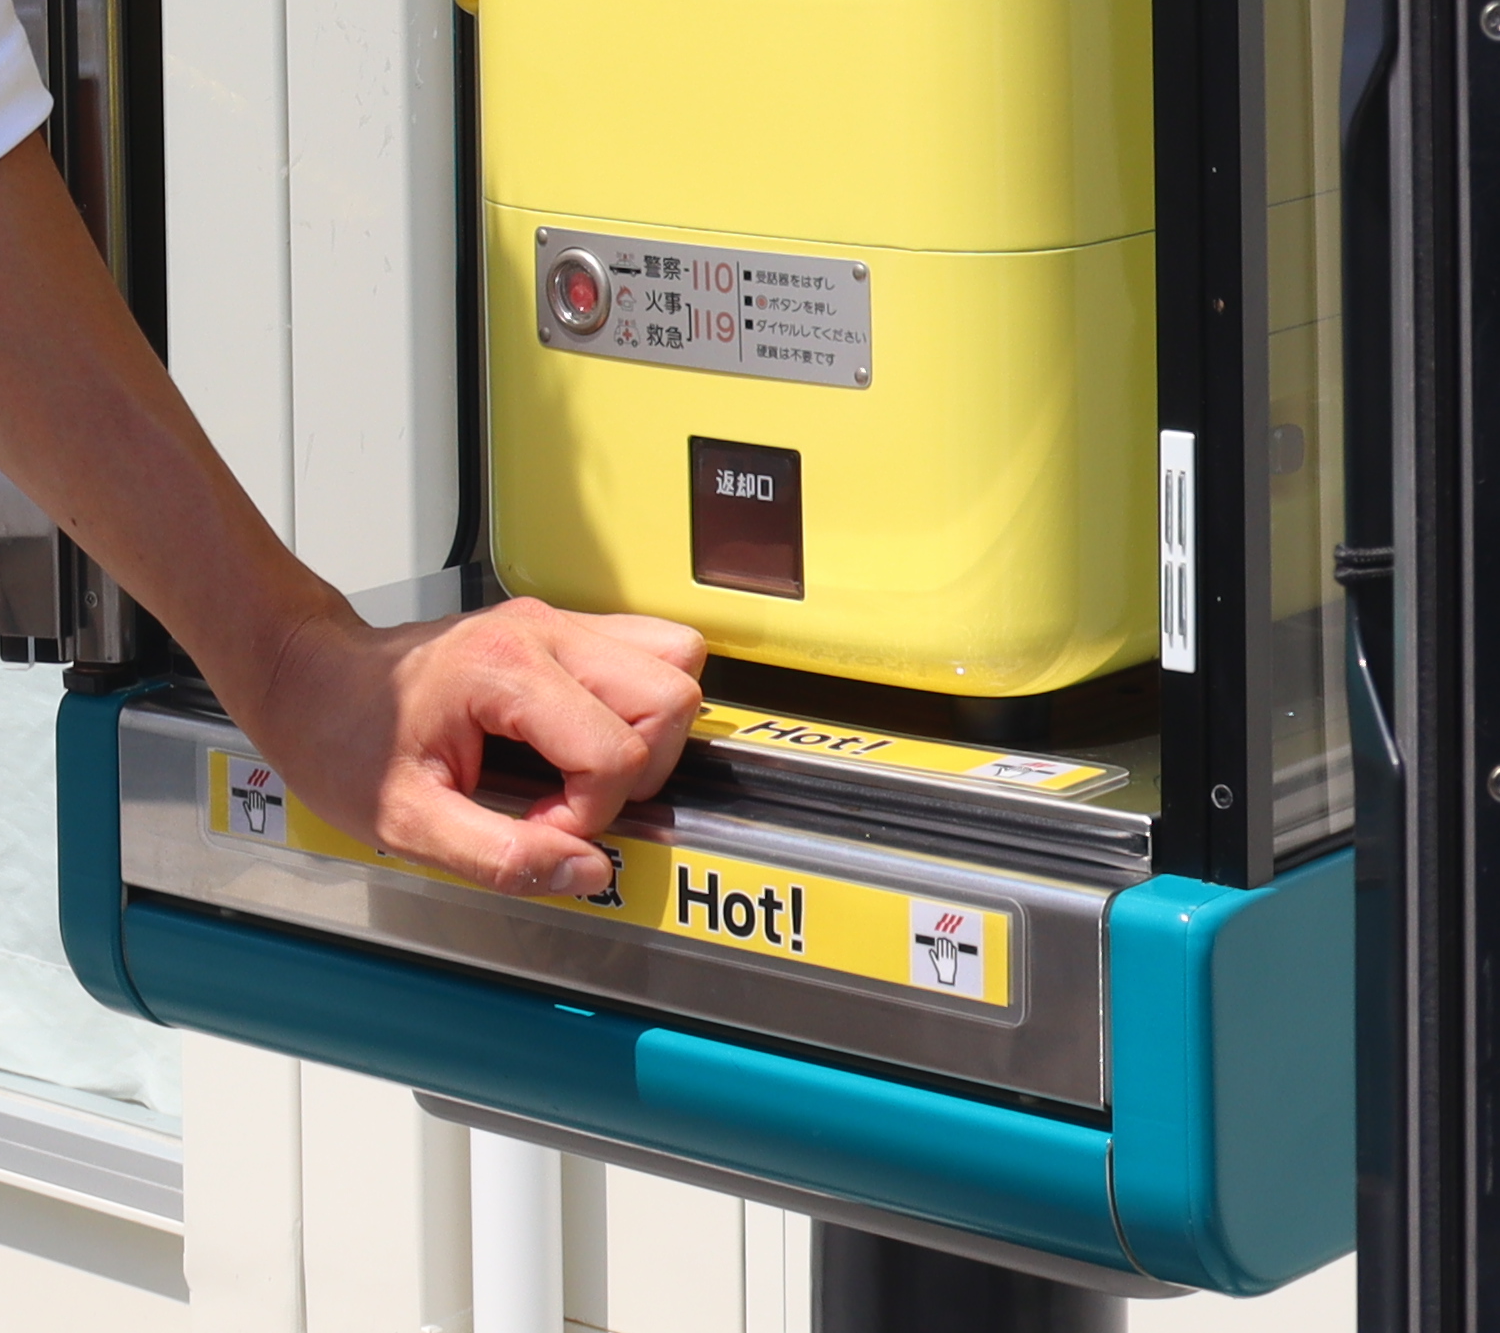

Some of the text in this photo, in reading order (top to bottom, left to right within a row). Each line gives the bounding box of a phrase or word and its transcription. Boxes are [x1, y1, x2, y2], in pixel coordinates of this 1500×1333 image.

[643, 255, 734, 294] 警察 110
[755, 270, 836, 291] 受話器をはずし
[645, 290, 682, 316] 火事
[768, 298, 837, 316] ボタンを押し
[646, 324, 684, 349] 救急
[694, 308, 735, 343] 119
[756, 320, 867, 345] ダイヤルしてください
[715, 468, 774, 502] 返却口
[737, 719, 893, 755] Hot!
[676, 864, 804, 953] Hot!
